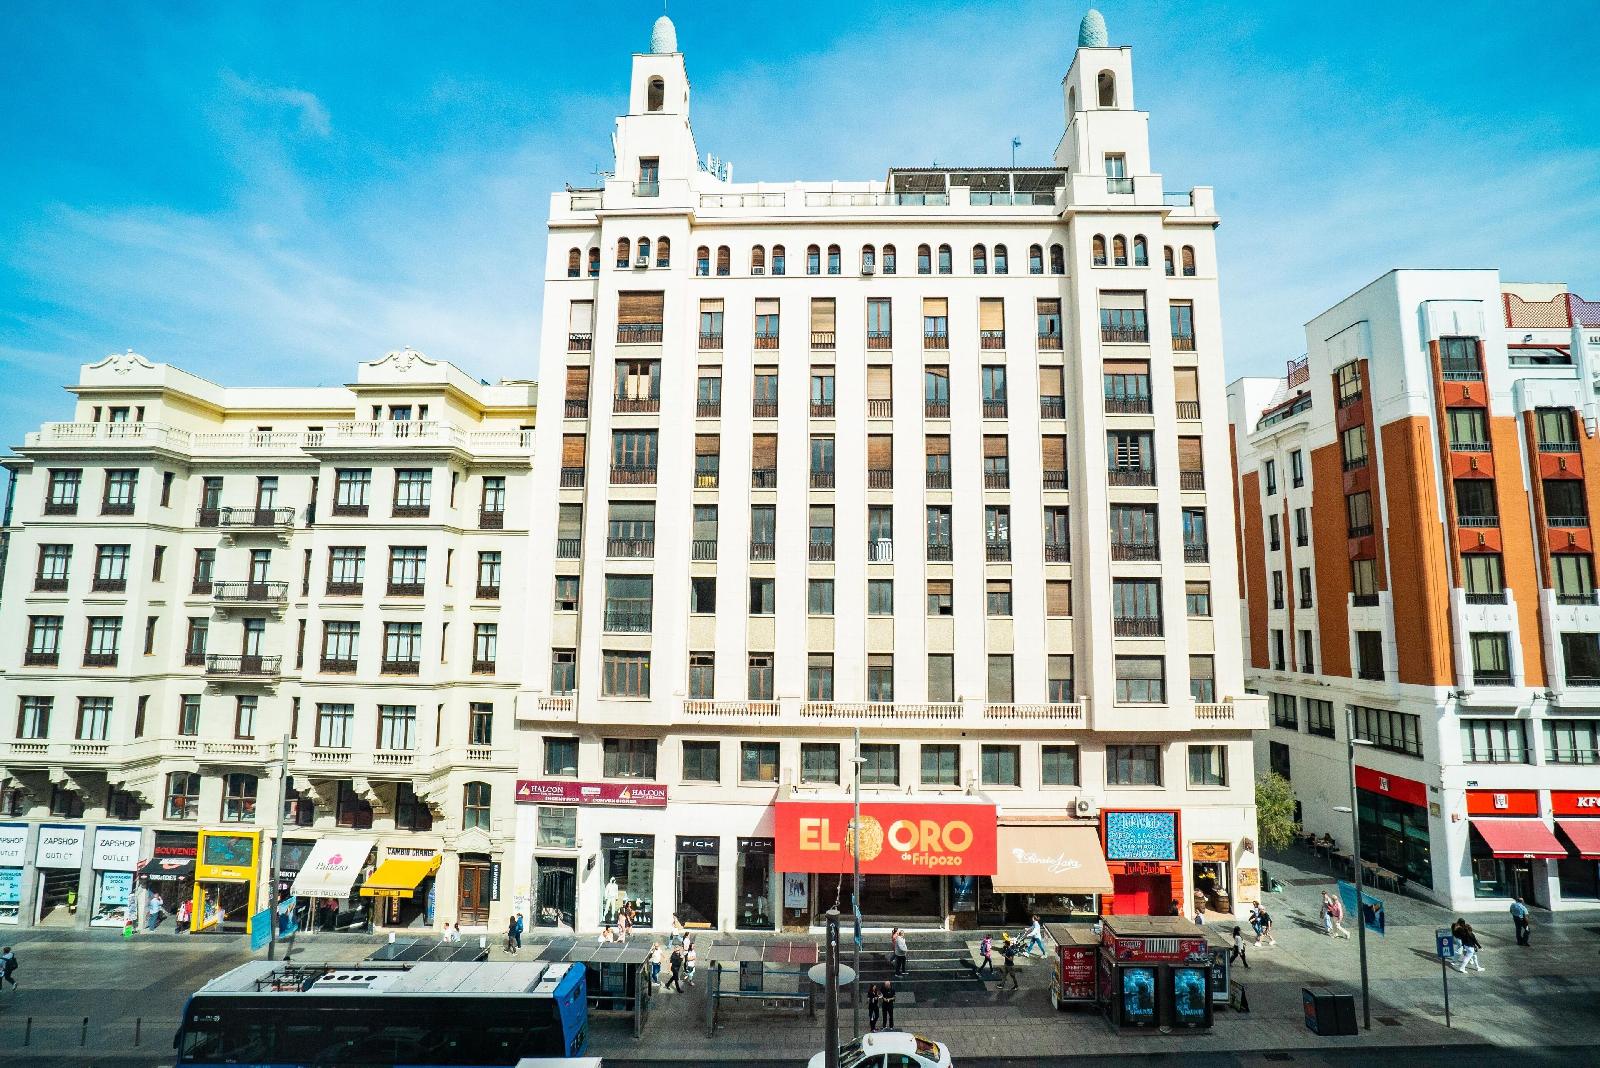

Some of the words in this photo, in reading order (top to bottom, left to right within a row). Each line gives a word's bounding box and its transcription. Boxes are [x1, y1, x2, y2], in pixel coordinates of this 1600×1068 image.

[531, 785, 563, 793] HALCON
[799, 818, 840, 850] EL
[888, 819, 973, 852] ORO
[43, 837, 79, 845] ZAPSHOP
[100, 839, 135, 847] ZAPSHOP
[45, 852, 72, 860] OUTLET
[102, 854, 129, 862] OUTLET
[912, 852, 963, 868] Fripozo
